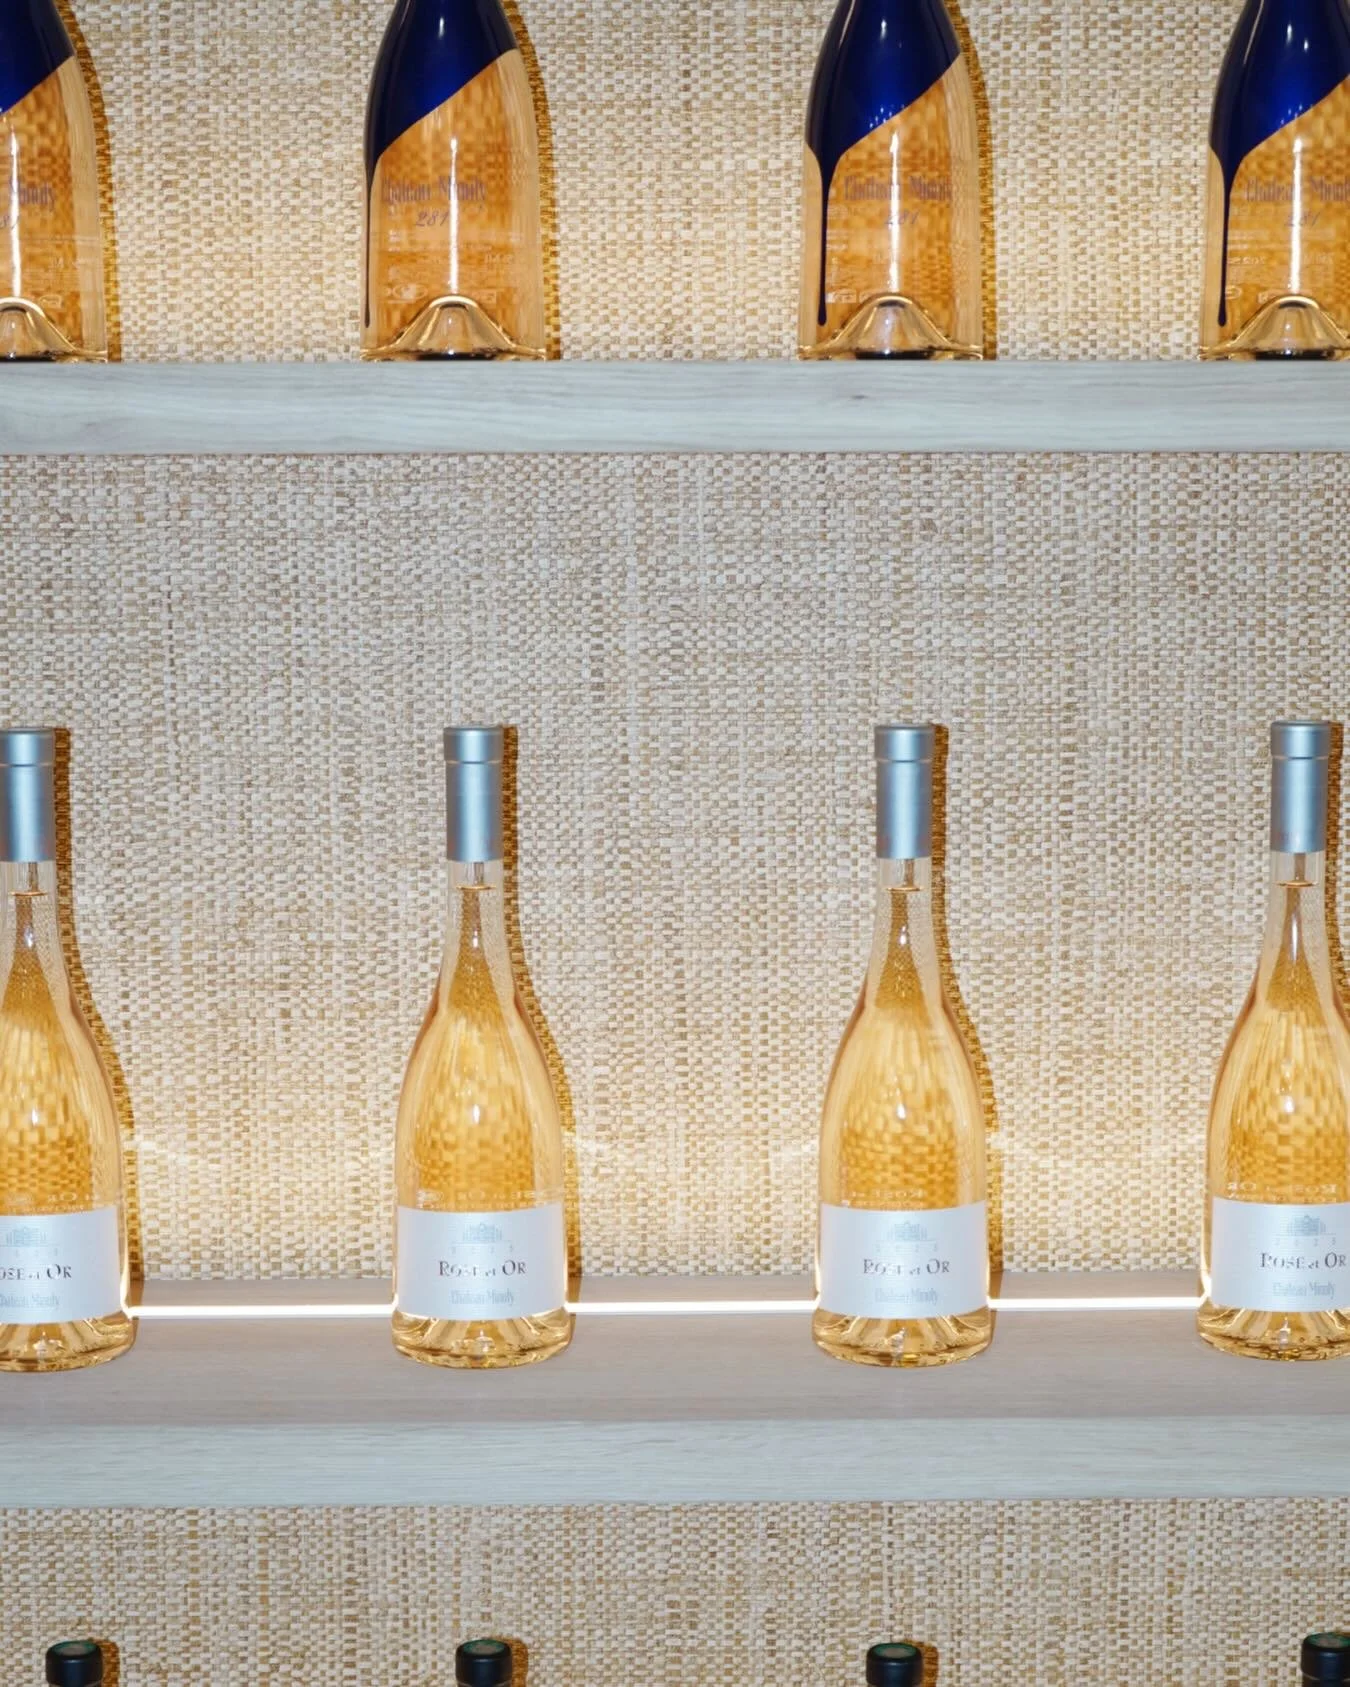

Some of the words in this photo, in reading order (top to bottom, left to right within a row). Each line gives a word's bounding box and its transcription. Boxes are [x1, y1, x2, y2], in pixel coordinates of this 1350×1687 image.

[501, 1259, 528, 1277] OR
[926, 1258, 951, 1275] OR
[1324, 1251, 1347, 1269] OR
